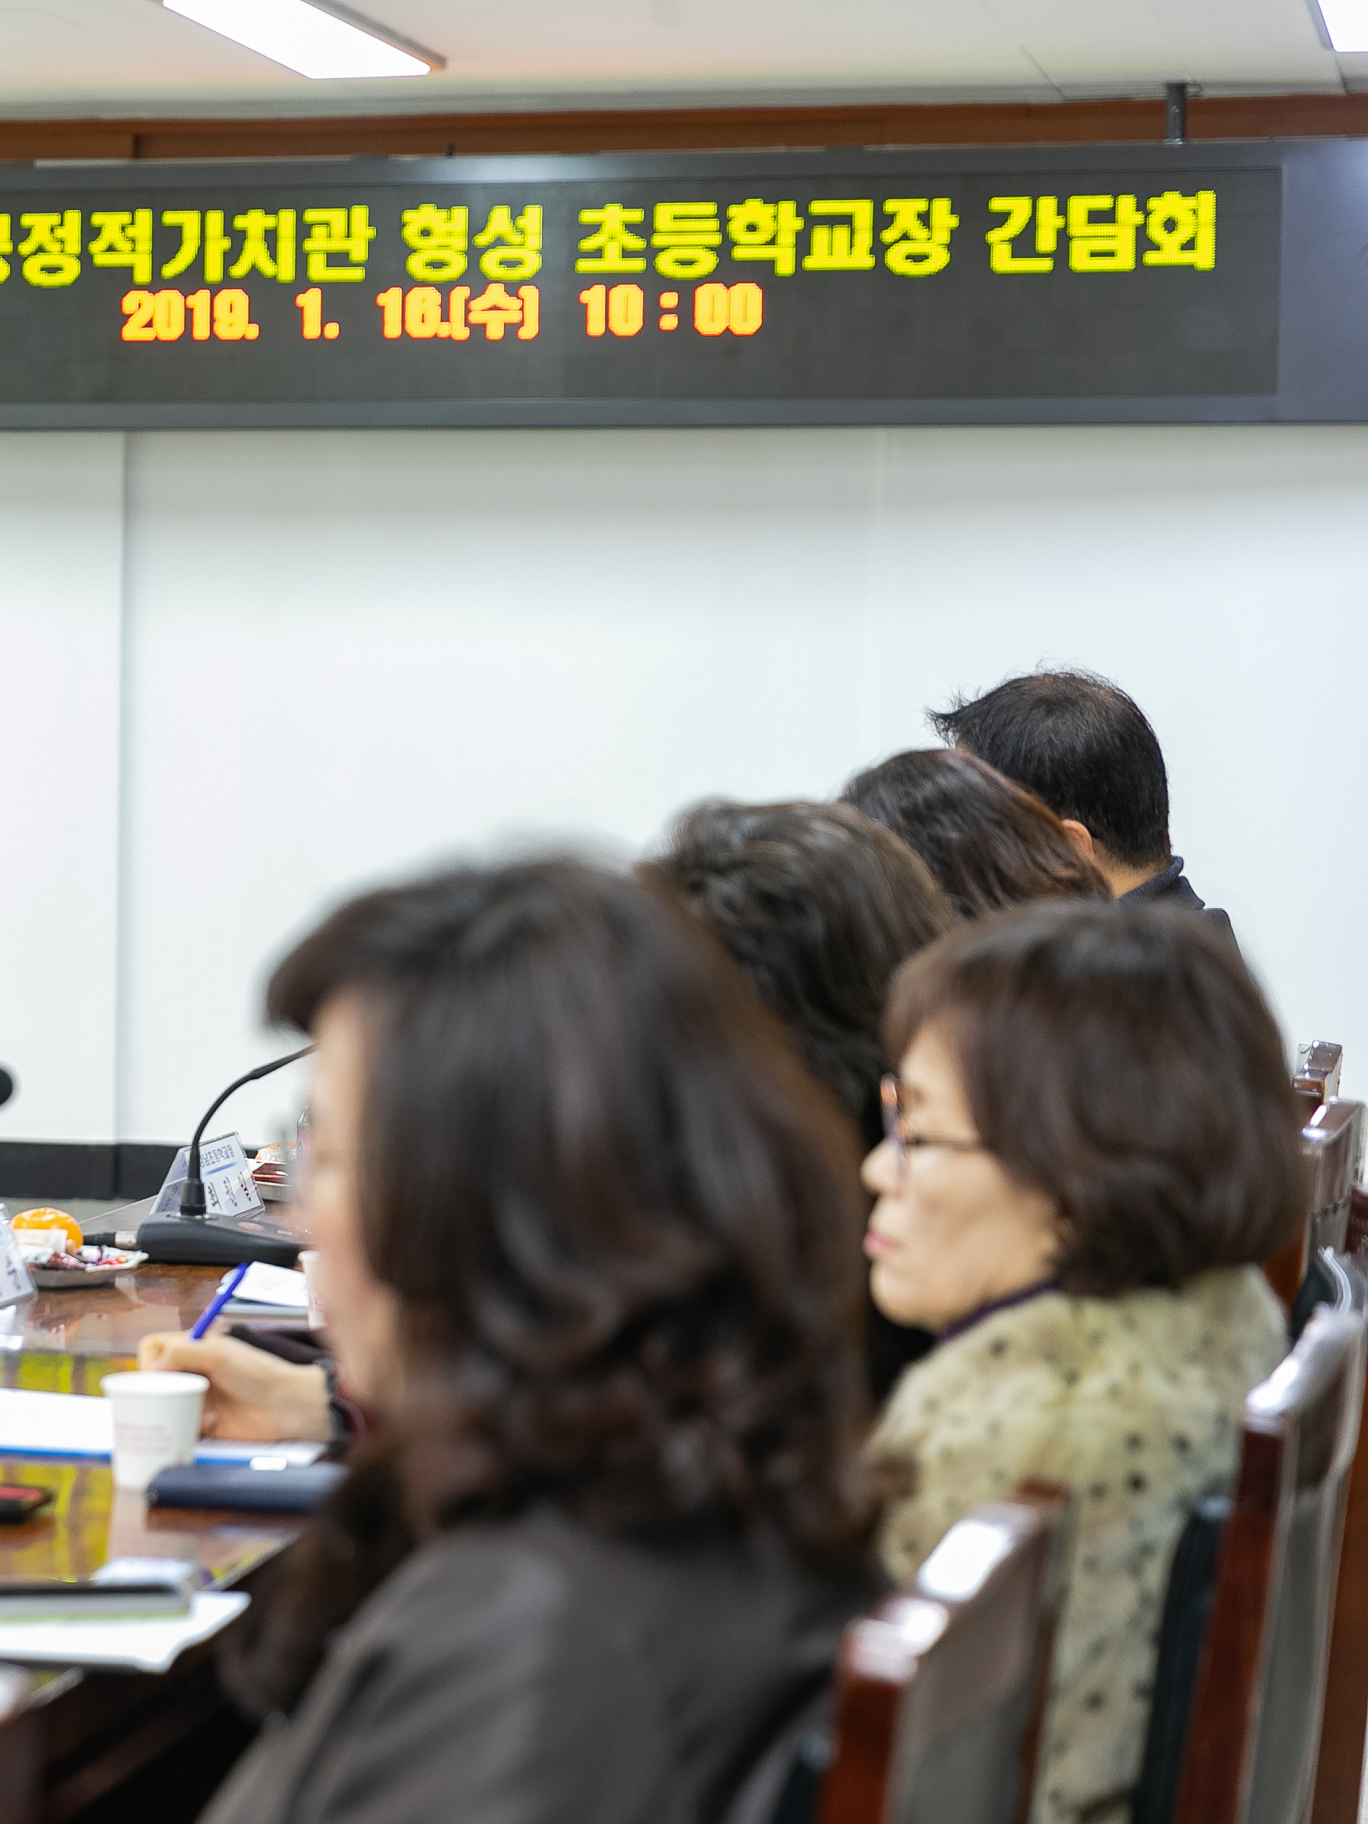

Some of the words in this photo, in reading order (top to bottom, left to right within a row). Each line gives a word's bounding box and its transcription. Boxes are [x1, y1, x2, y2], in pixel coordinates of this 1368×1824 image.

[402, 204, 543, 281] 형성
[575, 198, 959, 276] 초등학교장
[985, 191, 1216, 273] 간담회
[120, 289, 260, 342] 2019.
[295, 287, 340, 340] 1.
